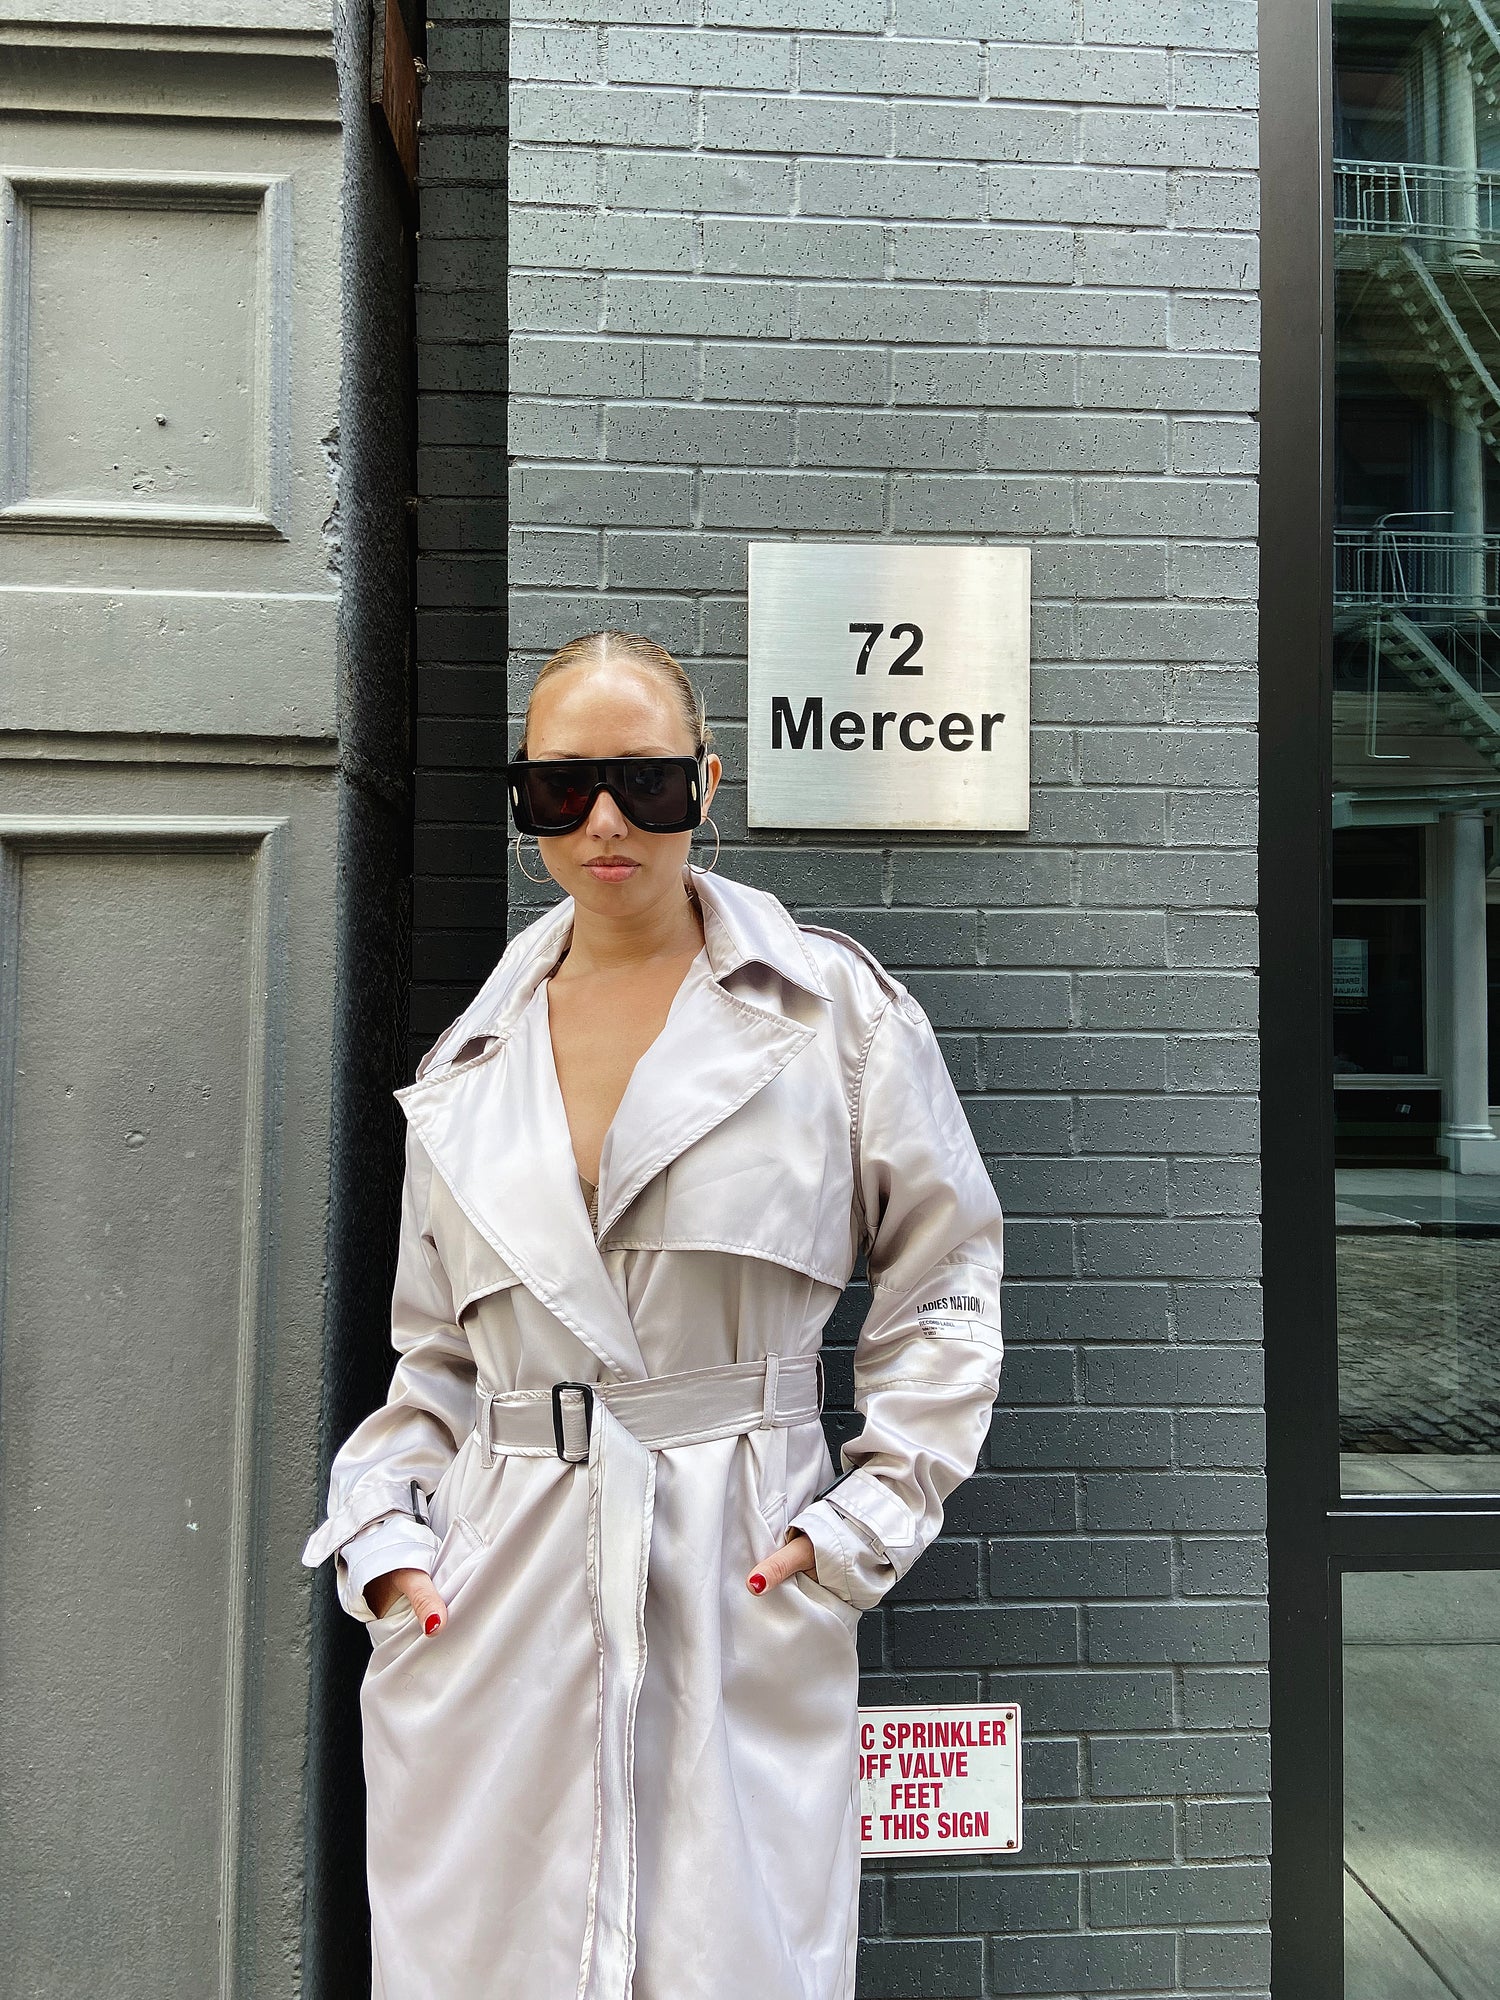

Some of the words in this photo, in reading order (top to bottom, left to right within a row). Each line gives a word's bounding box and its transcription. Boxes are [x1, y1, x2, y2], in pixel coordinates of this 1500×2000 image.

[848, 622, 924, 676] 72
[771, 696, 1006, 752] Mercer
[917, 1297, 948, 1314] LADIES
[949, 1295, 981, 1313] NATION
[882, 1720, 1007, 1749] SPRINKLER
[898, 1751, 968, 1779] VALVE
[891, 1782, 943, 1810] FEET
[880, 1813, 930, 1840] THIS
[937, 1811, 989, 1839] SIGN
